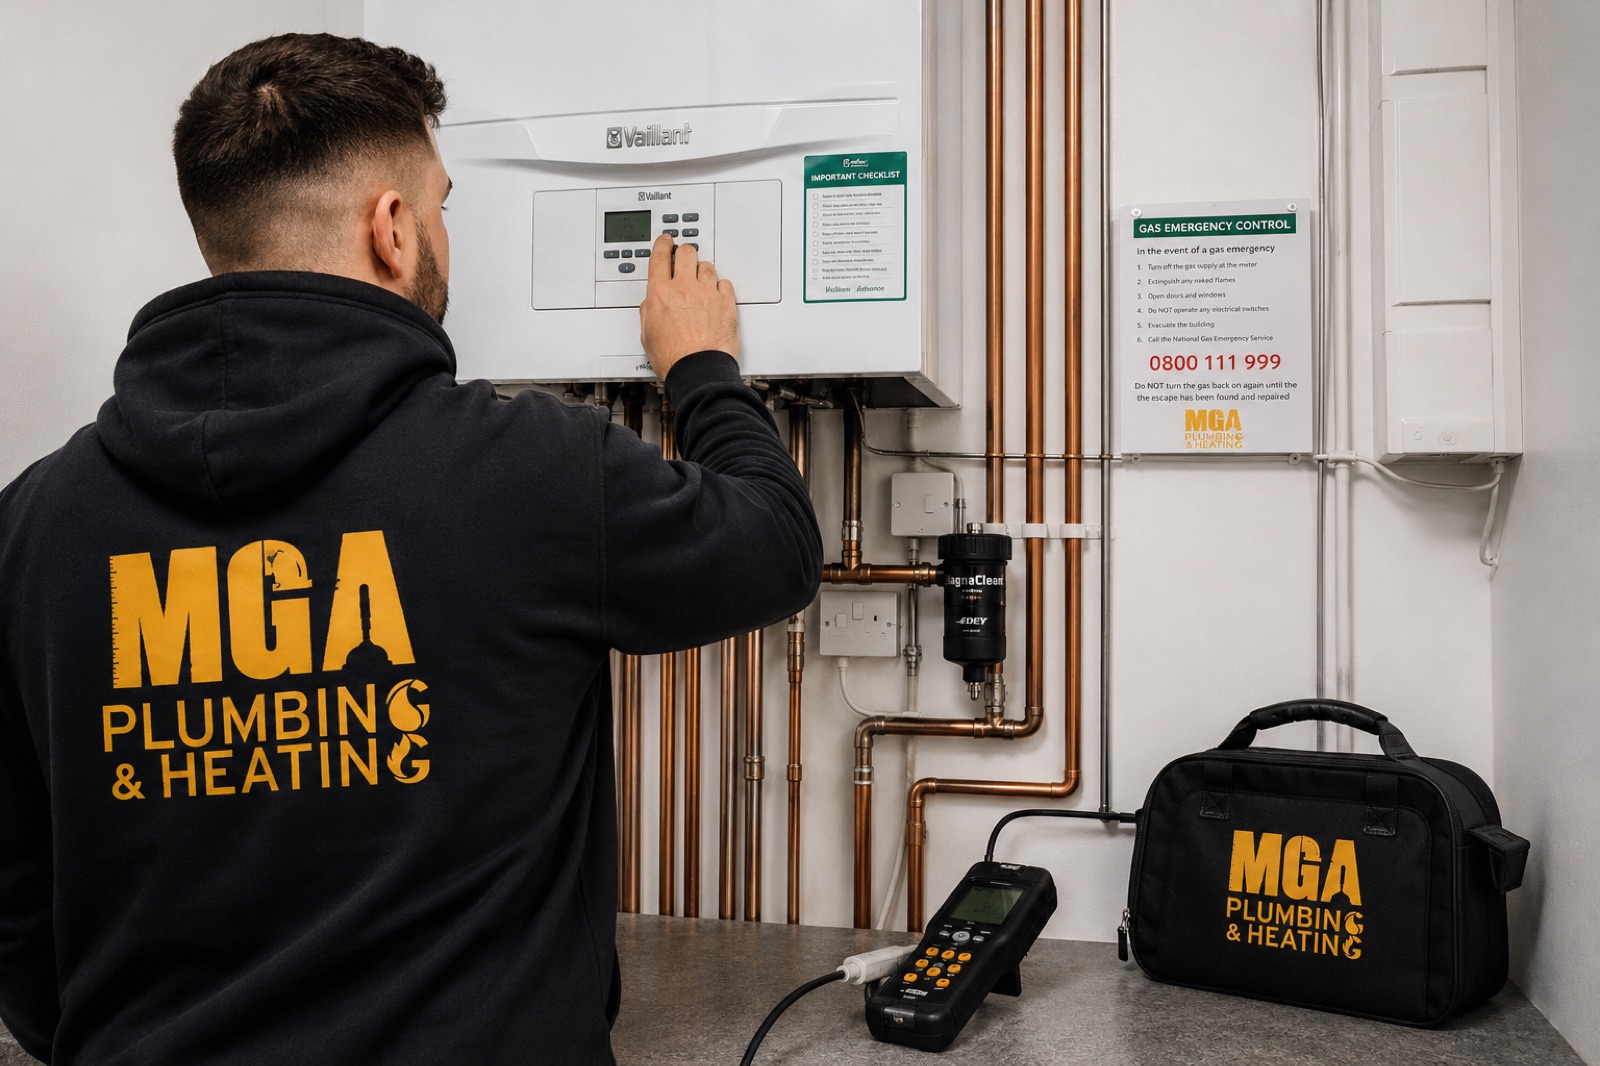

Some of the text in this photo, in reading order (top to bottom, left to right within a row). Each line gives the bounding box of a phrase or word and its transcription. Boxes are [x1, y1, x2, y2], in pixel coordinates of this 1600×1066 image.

[623, 123, 692, 148] Vaillant
[811, 171, 900, 182] IMPORTANT CHECKLIST
[645, 192, 672, 200] Vaillant
[1139, 220, 1290, 233] GAS EMERGENCY CONTROL
[1147, 247, 1162, 255] the
[1191, 246, 1200, 254] of
[1209, 247, 1224, 255] gas
[1226, 245, 1275, 255] emergency
[1150, 354, 1281, 371] 0800 111 999
[1243, 382, 1264, 390] again
[1152, 395, 1178, 403] escape
[1257, 393, 1290, 401] repaired
[1185, 409, 1242, 431] MGA
[1185, 433, 1243, 441] PLUMBING
[1196, 441, 1243, 449] HEATING
[109, 530, 416, 689] MGA
[102, 678, 430, 752] PLUMBING
[112, 733, 430, 800] & HEATING
[1228, 830, 1362, 906] MGA
[1226, 896, 1364, 935] PLUMBING
[1226, 923, 1362, 960] & HEATING
